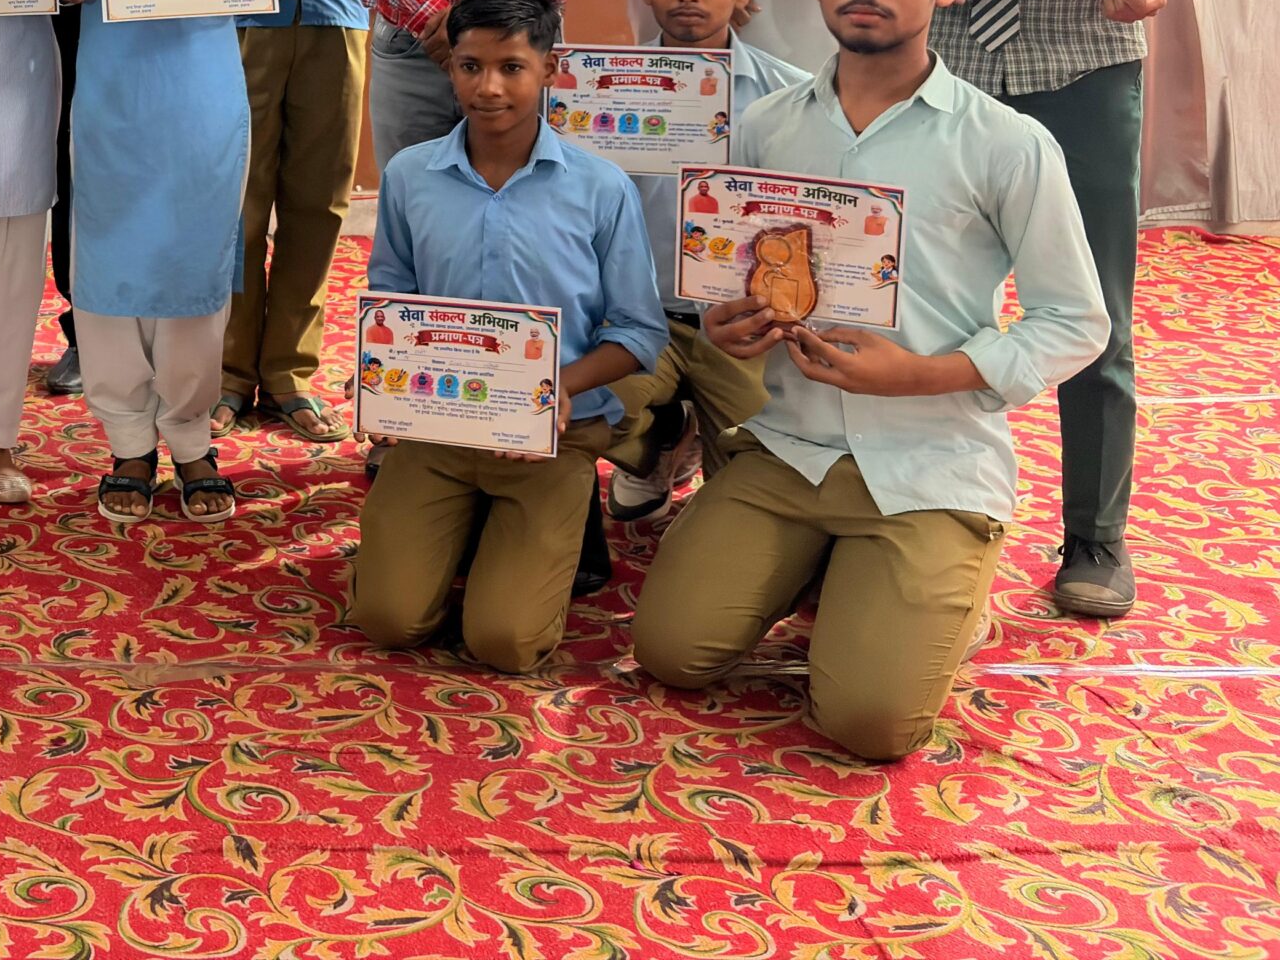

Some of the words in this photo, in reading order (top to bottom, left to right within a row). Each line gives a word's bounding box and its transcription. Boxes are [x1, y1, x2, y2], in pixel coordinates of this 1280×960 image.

[581, 55, 605, 68] सेवा
[609, 56, 644, 67] संकल्प
[648, 57, 695, 72] अभियान
[611, 75, 662, 85] प्रमाण-पत्र
[724, 177, 753, 192] सेवा
[757, 181, 798, 196] संकल्प
[802, 186, 859, 207] अभियान
[759, 203, 820, 219] प्रमाण-पत्र
[398, 306, 425, 321] सेवा
[428, 309, 466, 324] संकल्प
[470, 312, 520, 332] अभियान
[431, 331, 485, 345] प्रमाण-पत्र
